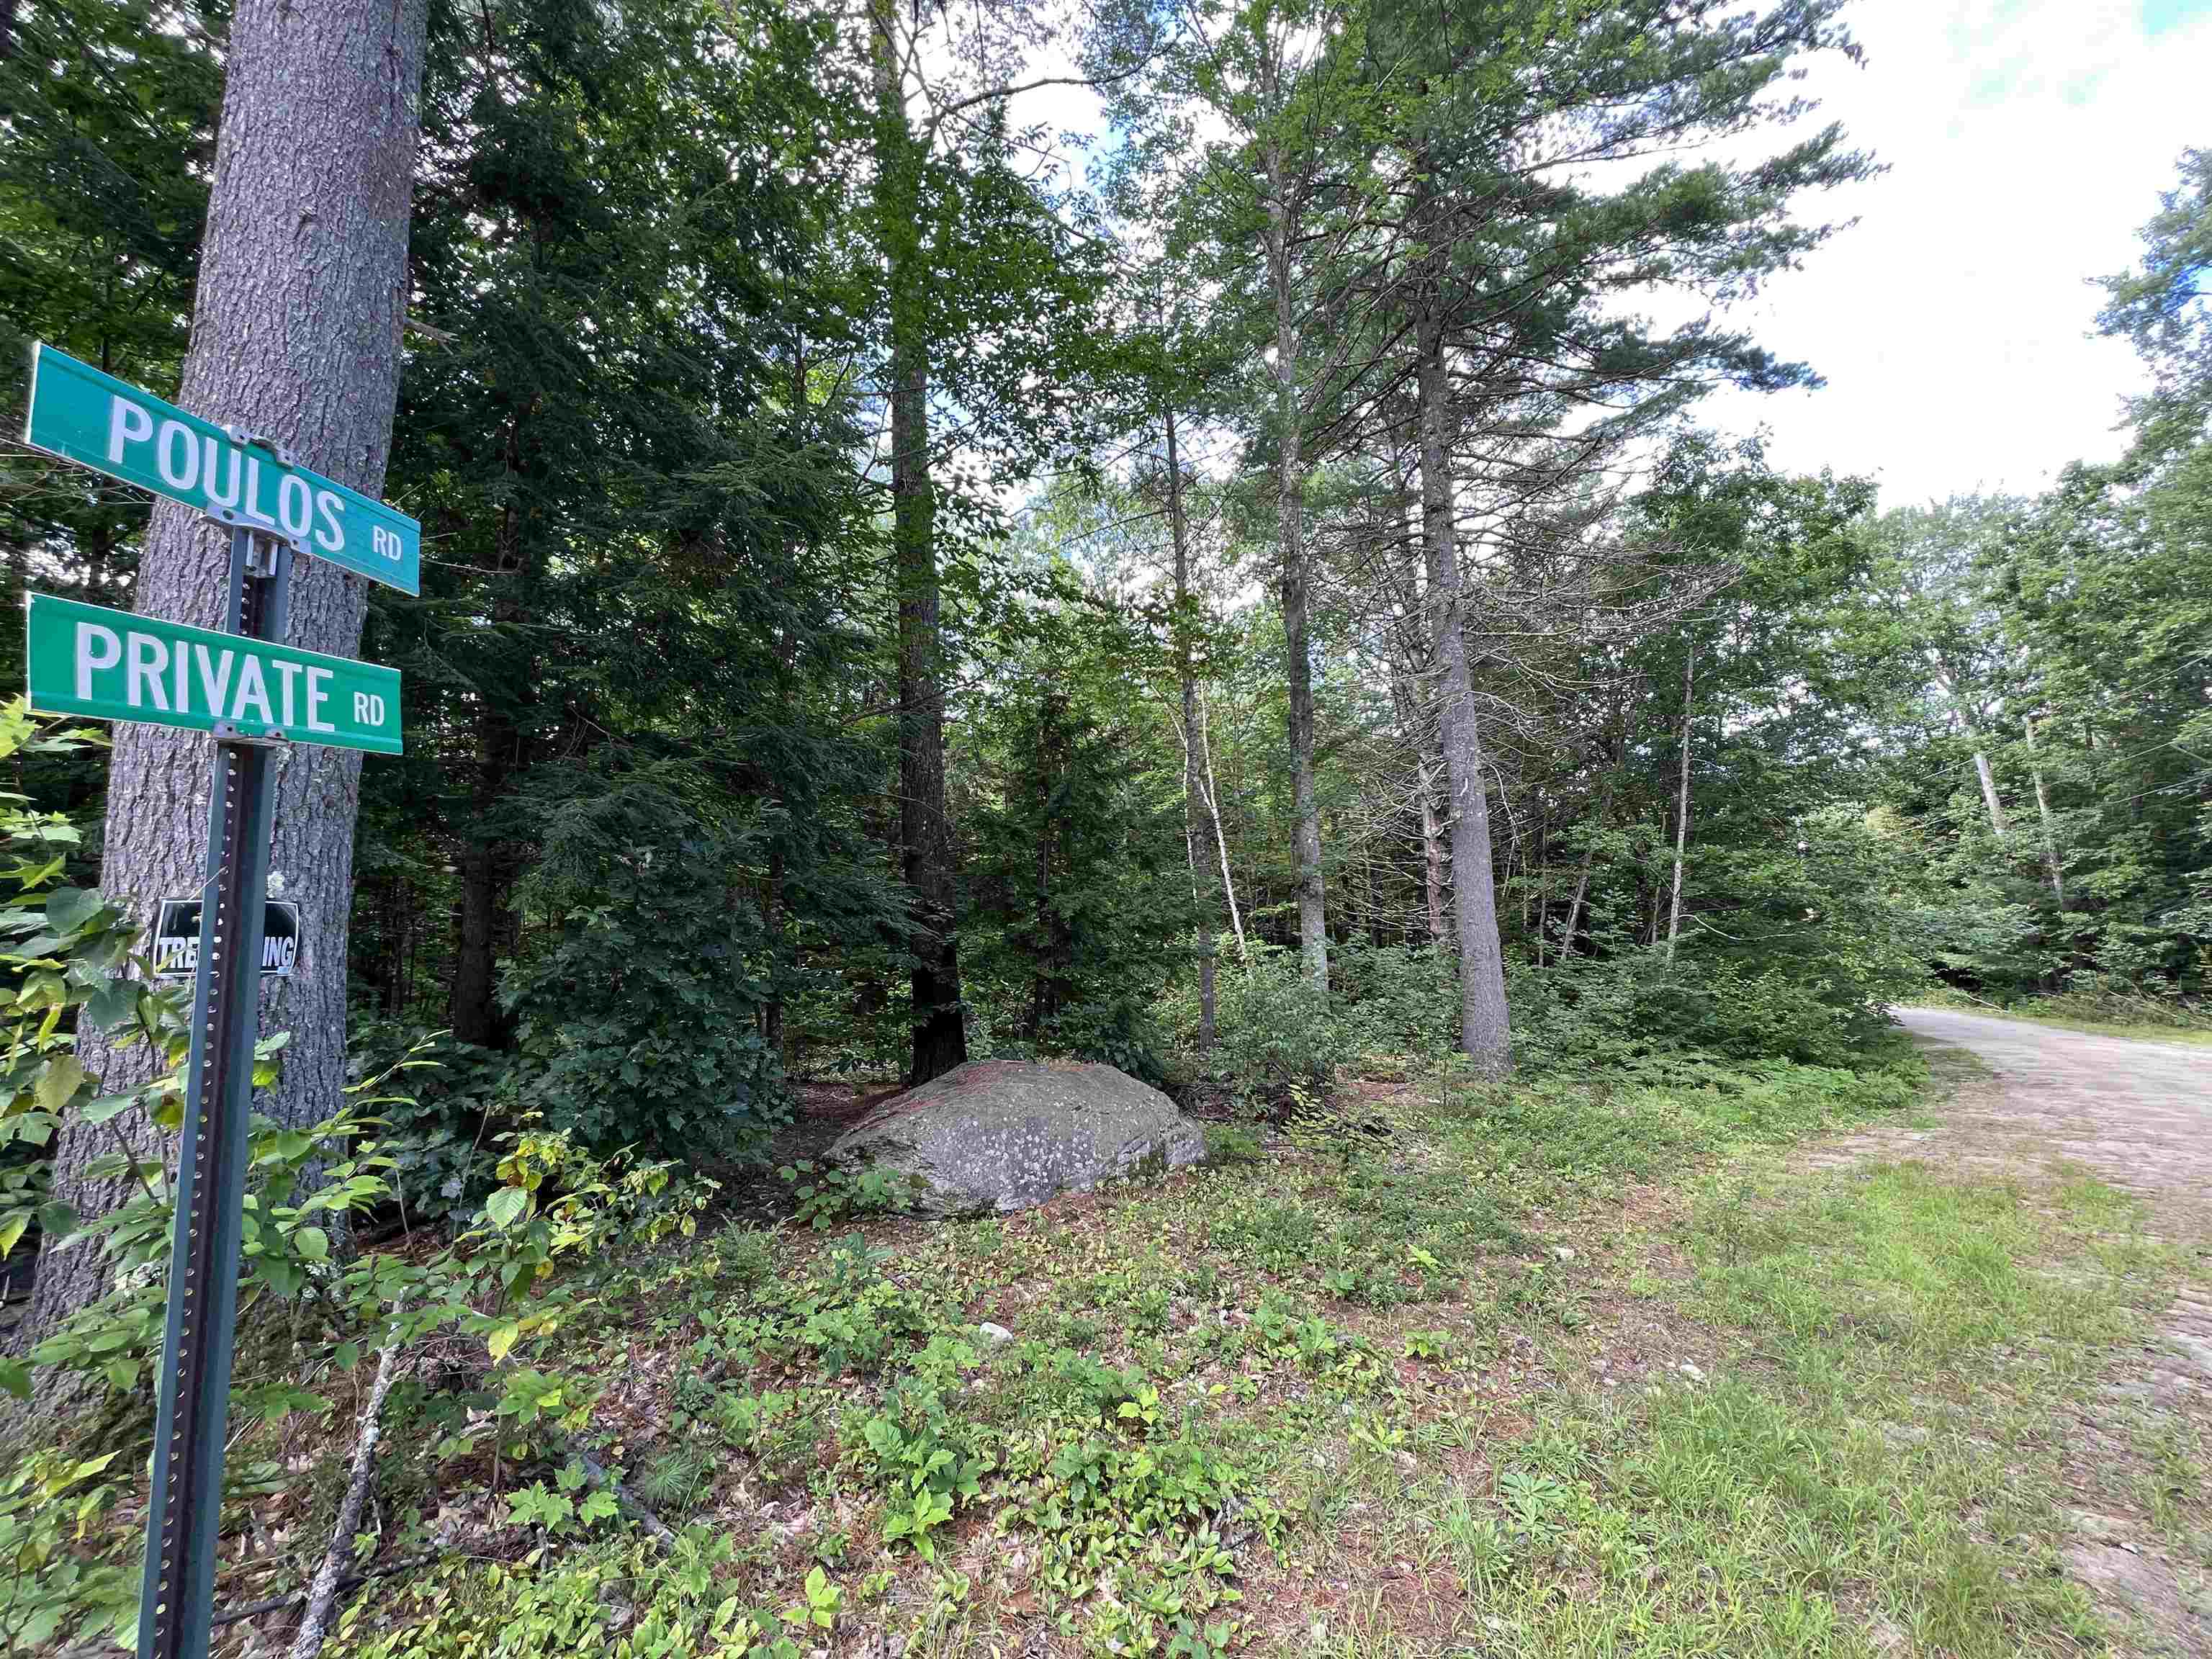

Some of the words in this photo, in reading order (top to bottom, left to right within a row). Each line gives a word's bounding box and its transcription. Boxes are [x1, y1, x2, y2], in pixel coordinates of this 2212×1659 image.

[108, 395, 345, 552] POULOS
[373, 525, 402, 562] RD
[76, 621, 335, 732] PRIVATE
[354, 691, 385, 727] RD
[159, 936, 295, 969] TREING
